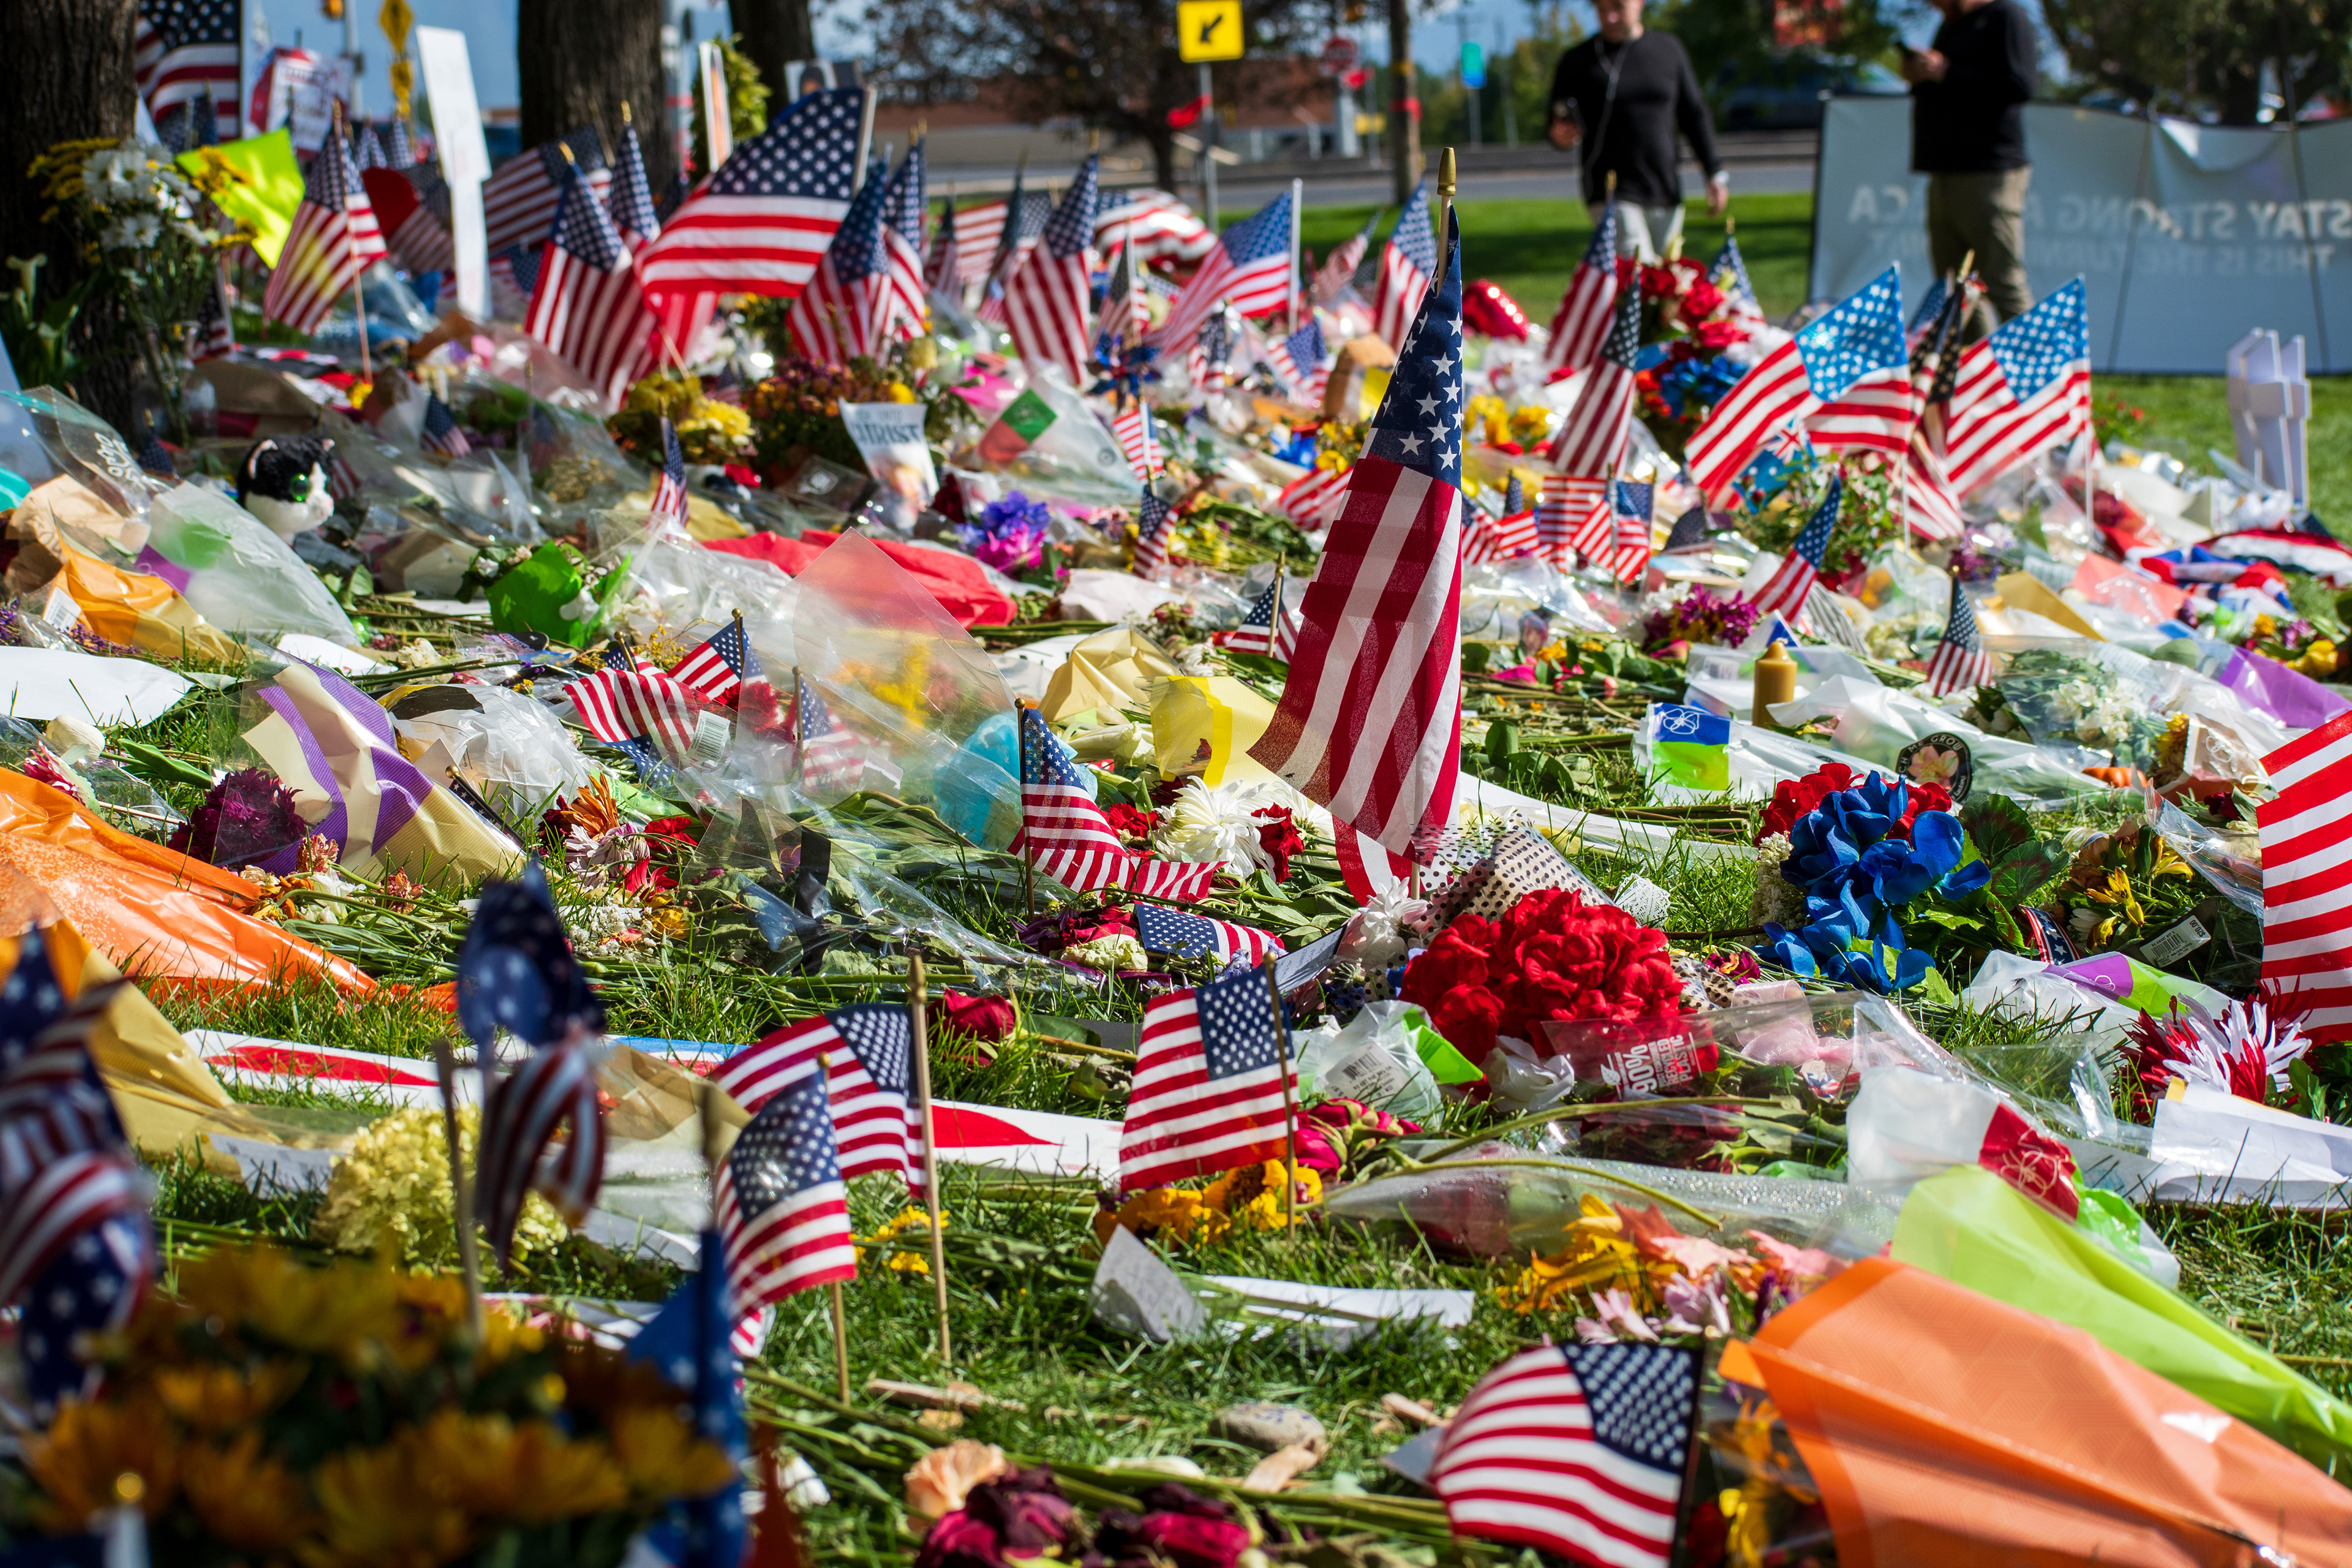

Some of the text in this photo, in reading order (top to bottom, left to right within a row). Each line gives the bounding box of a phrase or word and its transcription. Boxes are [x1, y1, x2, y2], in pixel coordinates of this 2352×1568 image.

[1908, 734, 1962, 753] ME GROW
[2189, 919, 2206, 937] $20.00
[1623, 1044, 1658, 1093] 90%
[1657, 1038, 1679, 1086] RECYCLED
[1670, 1034, 1695, 1082] PLASTIC
